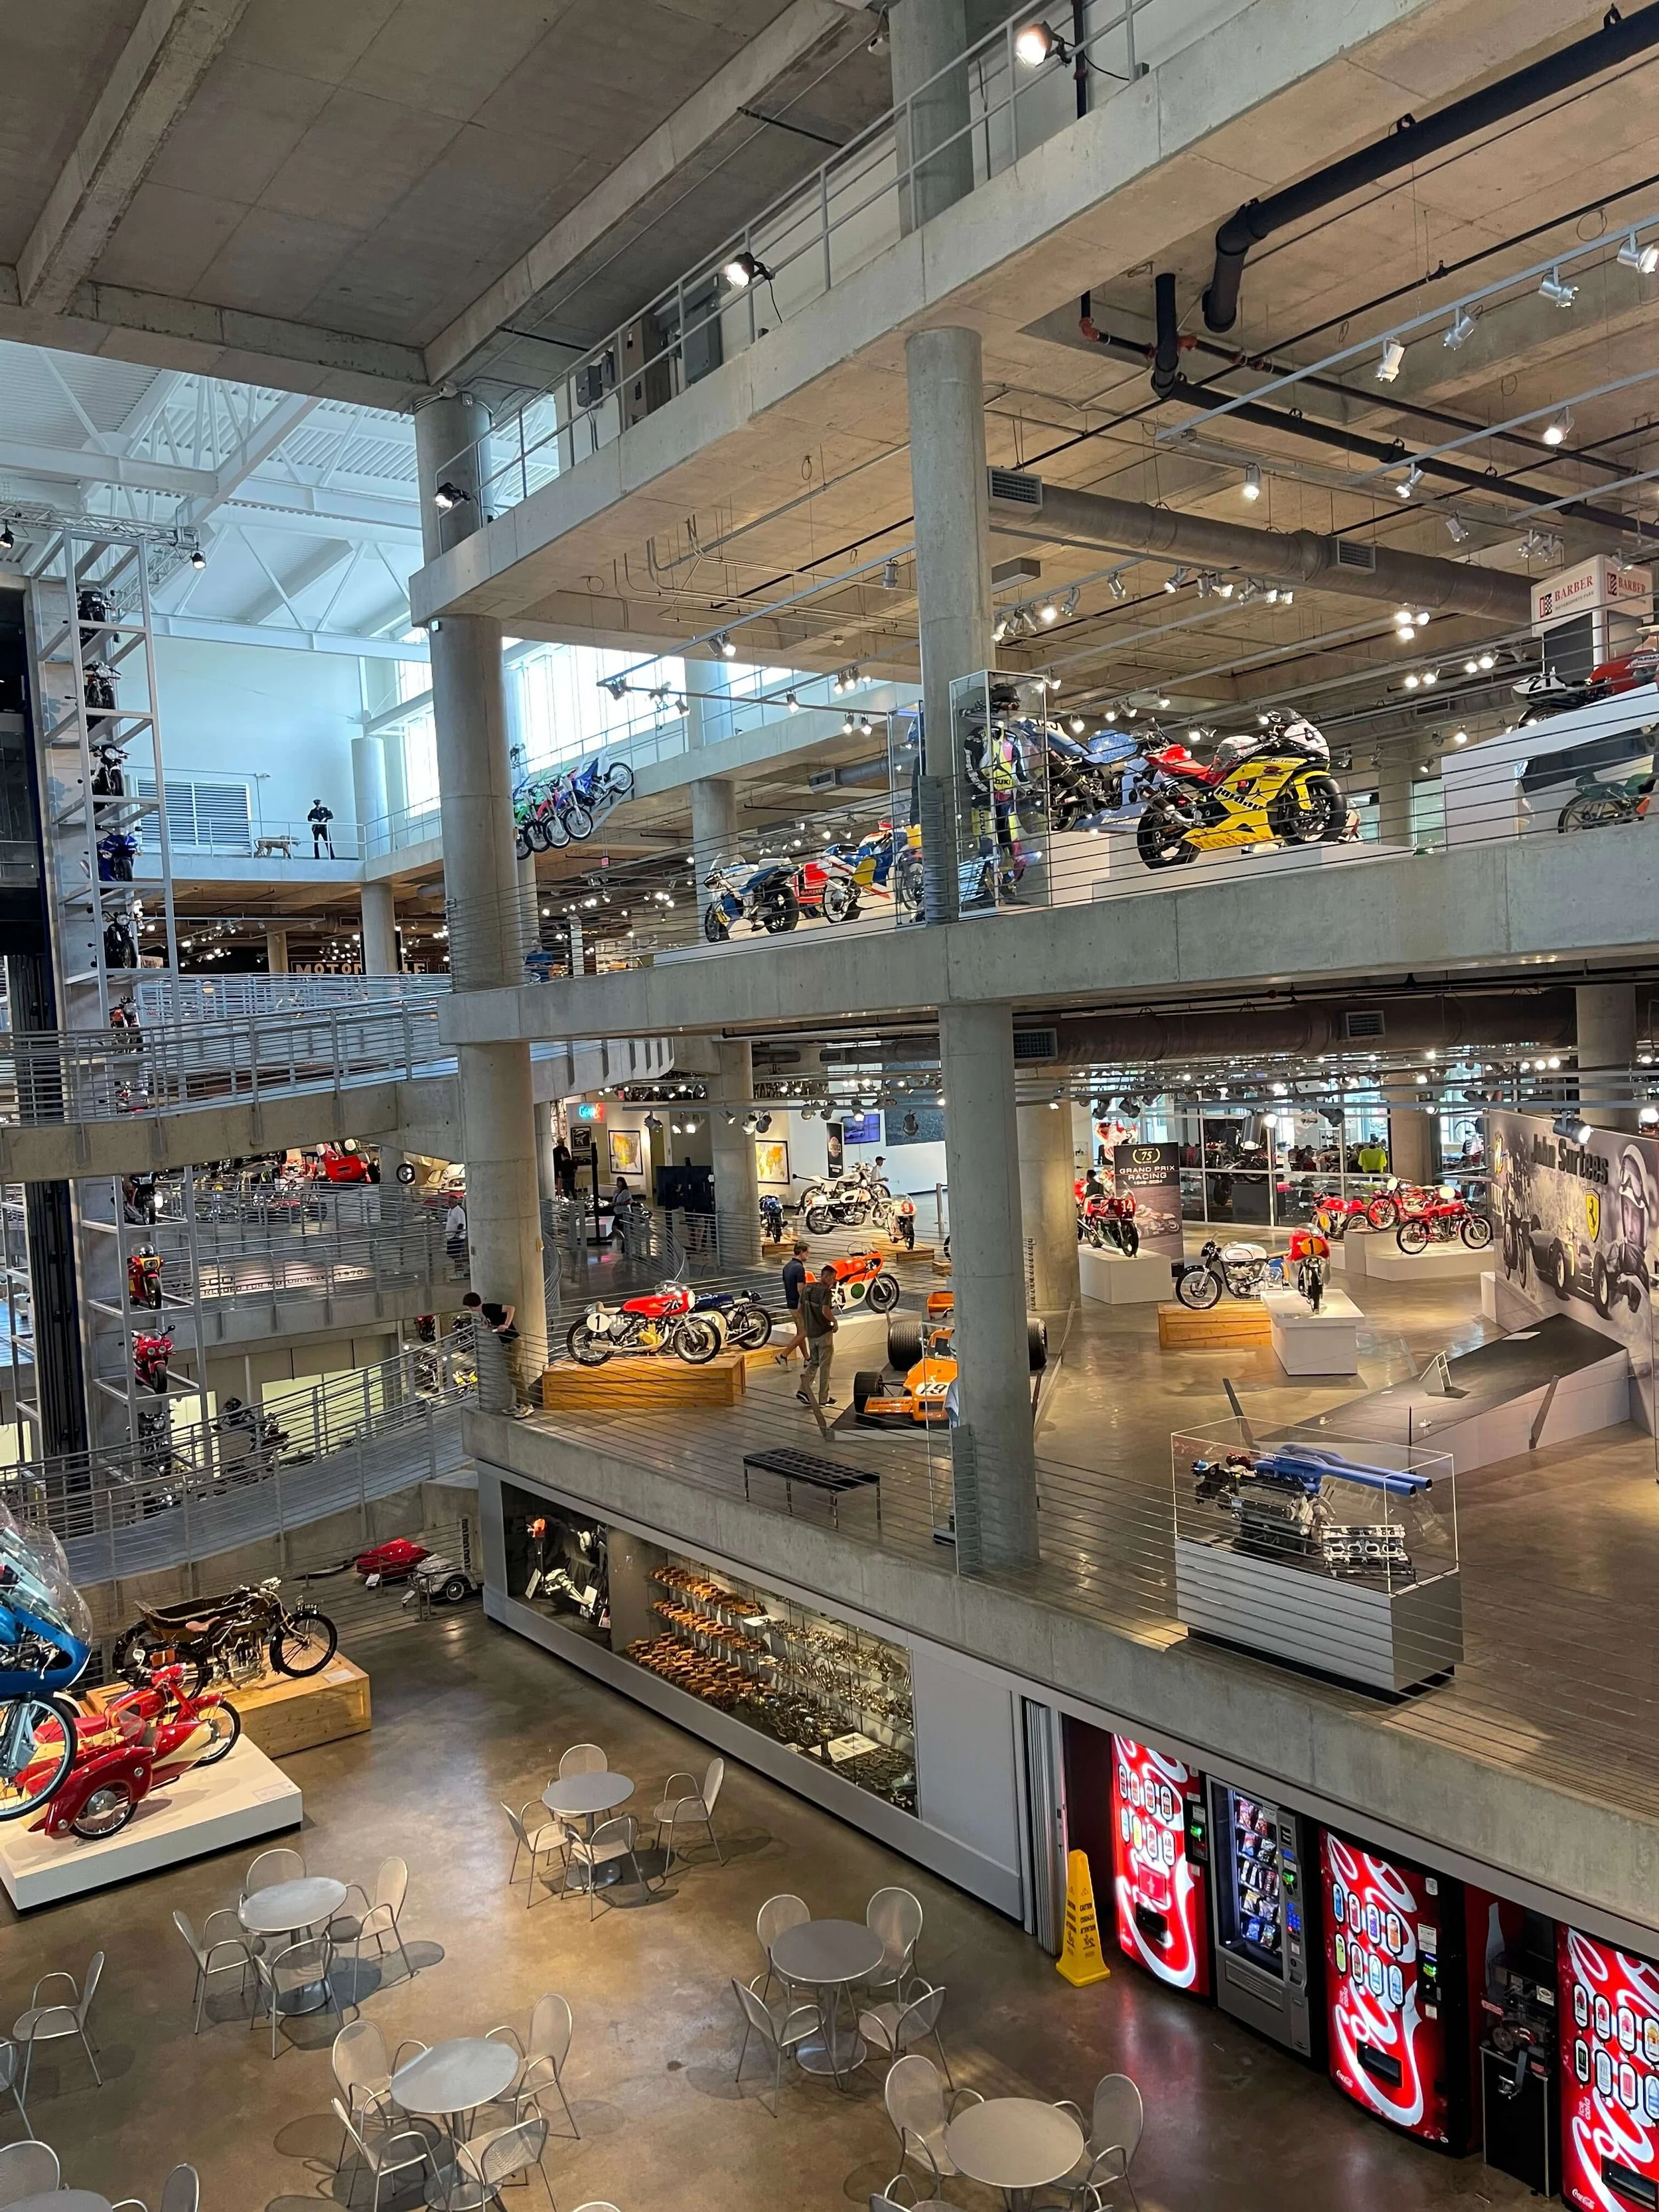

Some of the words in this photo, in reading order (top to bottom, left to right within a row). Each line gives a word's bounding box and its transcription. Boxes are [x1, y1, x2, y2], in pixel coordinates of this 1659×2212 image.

[1555, 575, 1593, 601] BARBER
[1618, 577, 1646, 595] BARBER
[1141, 1151, 1153, 1161] 75
[1531, 1134, 1557, 1169] John
[1558, 1138, 1610, 1186] Surtees
[1119, 1166, 1152, 1175] GRAND
[1127, 1172, 1167, 1181] RACING
[1120, 1199, 1133, 1213] 14
[1308, 1238, 1315, 1255] 1
[595, 1315, 601, 1331] 1
